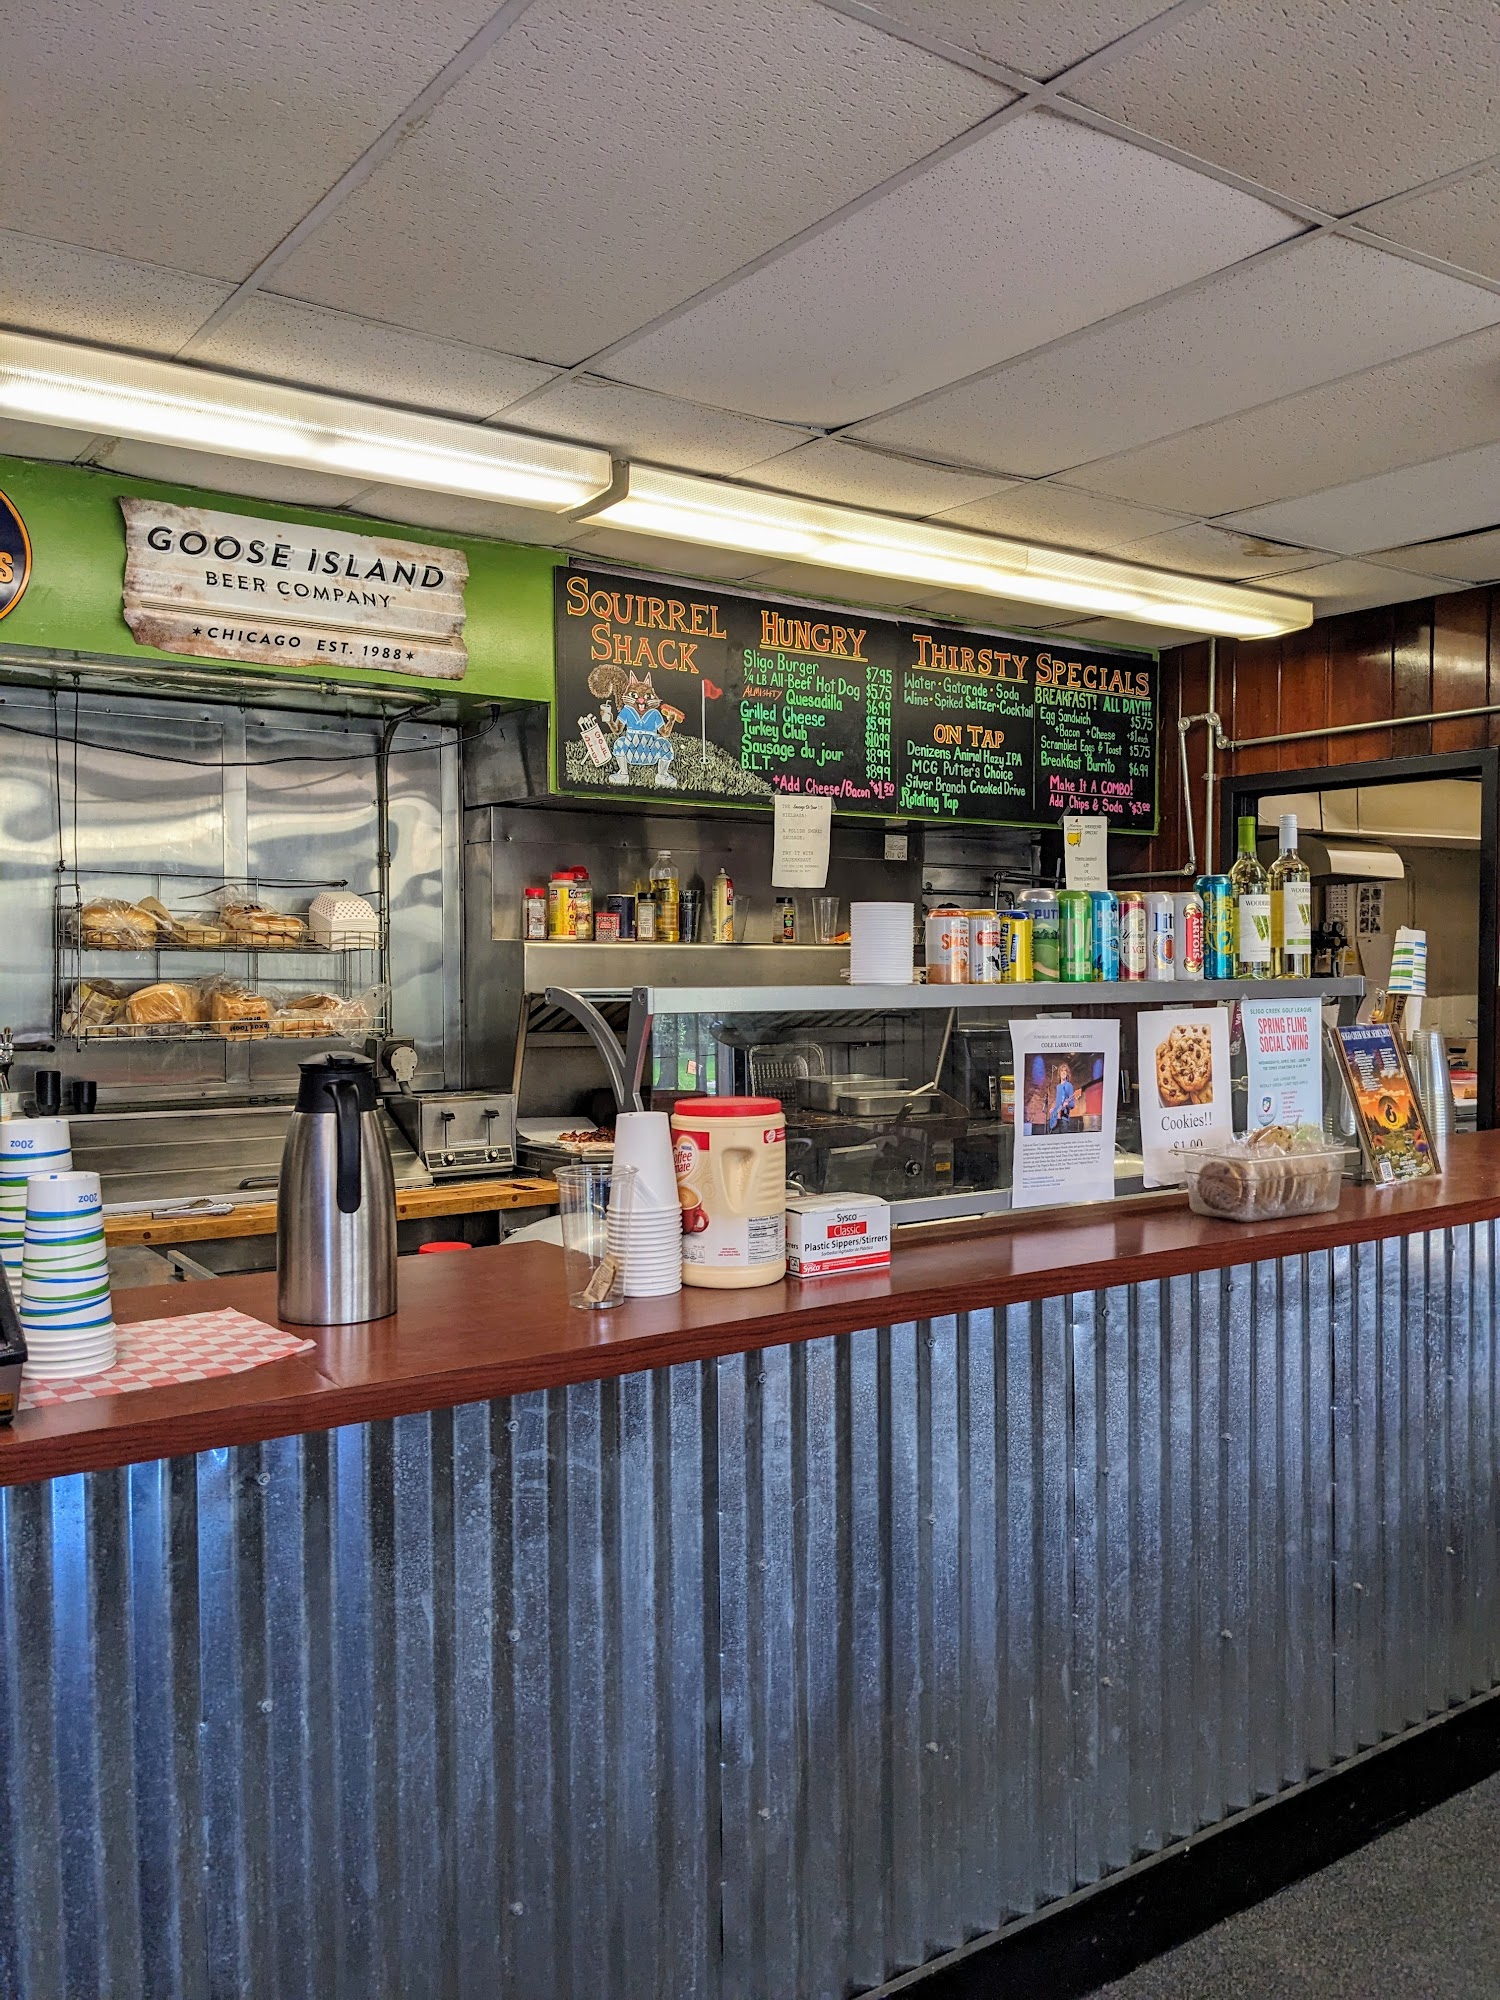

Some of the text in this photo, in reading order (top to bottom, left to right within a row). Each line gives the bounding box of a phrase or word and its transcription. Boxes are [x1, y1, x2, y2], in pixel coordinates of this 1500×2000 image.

[148, 526, 444, 588] GOOSE ISLAND
[206, 571, 391, 608] BEER COMPANY
[567, 576, 727, 639] SQUIRREL
[208, 628, 401, 660] CHICAGO EST. 1988
[761, 610, 866, 657] HUNGRY
[591, 623, 699, 674] SHACK
[743, 649, 892, 684] Sligo Burger $7.95
[912, 634, 1150, 696] THIRSTY SPECIALS
[756, 674, 767, 686] LB
[770, 674, 812, 690] All-Beef
[816, 676, 836, 693] Hot
[838, 678, 860, 701] Dog
[866, 684, 892, 701] $5.75
[904, 672, 1020, 700] Water Gatorade Soda
[786, 689, 843, 712] Quesadilla
[866, 701, 890, 717] $6.99
[904, 690, 1034, 719] Wine Spiked Seltzer Cocktail
[1034, 686, 1152, 717] BREAKFAST! ALL DAY!!!
[740, 700, 891, 733] Grilled Cheese $5.99
[1040, 706, 1153, 731] Egg Sandwich $5.75
[741, 717, 890, 749] Turkey Club $10.99
[934, 724, 1004, 748] ON TAP
[1040, 735, 1078, 751] Scrambled
[1080, 740, 1096, 757] Eggs
[1104, 743, 1122, 756] Toast
[1130, 744, 1150, 758] $5.75
[741, 734, 891, 766] Sausage du jour $8.99
[907, 740, 1022, 768] Denizens Animal Hazy IPA
[1040, 750, 1149, 778] Breakfast Burrito $6.99
[741, 752, 891, 781] B.L.T. $8.99
[912, 760, 1014, 781] MCG Putter's Choice
[806, 778, 871, 798] Cheese/Bacon
[906, 773, 1026, 796] Silver Branch Crooked Drive
[1050, 775, 1134, 796] Make It A COMBO!
[900, 786, 959, 816] Rotating Tap
[1049, 793, 1064, 808] Add
[1069, 794, 1090, 814] Chips
[1092, 799, 1099, 812] &
[1102, 799, 1124, 814] Soda
[1154, 912, 1174, 934] Lit
[1001, 923, 1010, 973] TWISTED TEA
[1124, 946, 1146, 954] LAGE
[1192, 917, 1200, 959] ARTOIS
[1258, 1016, 1308, 1034] SPRING FLING
[1260, 1034, 1308, 1053] SOCIAL SWING
[1161, 1112, 1212, 1130] Cookies!!
[10, 1140, 34, 1148] 20oz
[78, 1192, 98, 1202] 20oz
[834, 1224, 860, 1237] Classic
[836, 1213, 858, 1224] Sysco
[804, 1234, 888, 1252] Plastic Sippers/Stirrers
